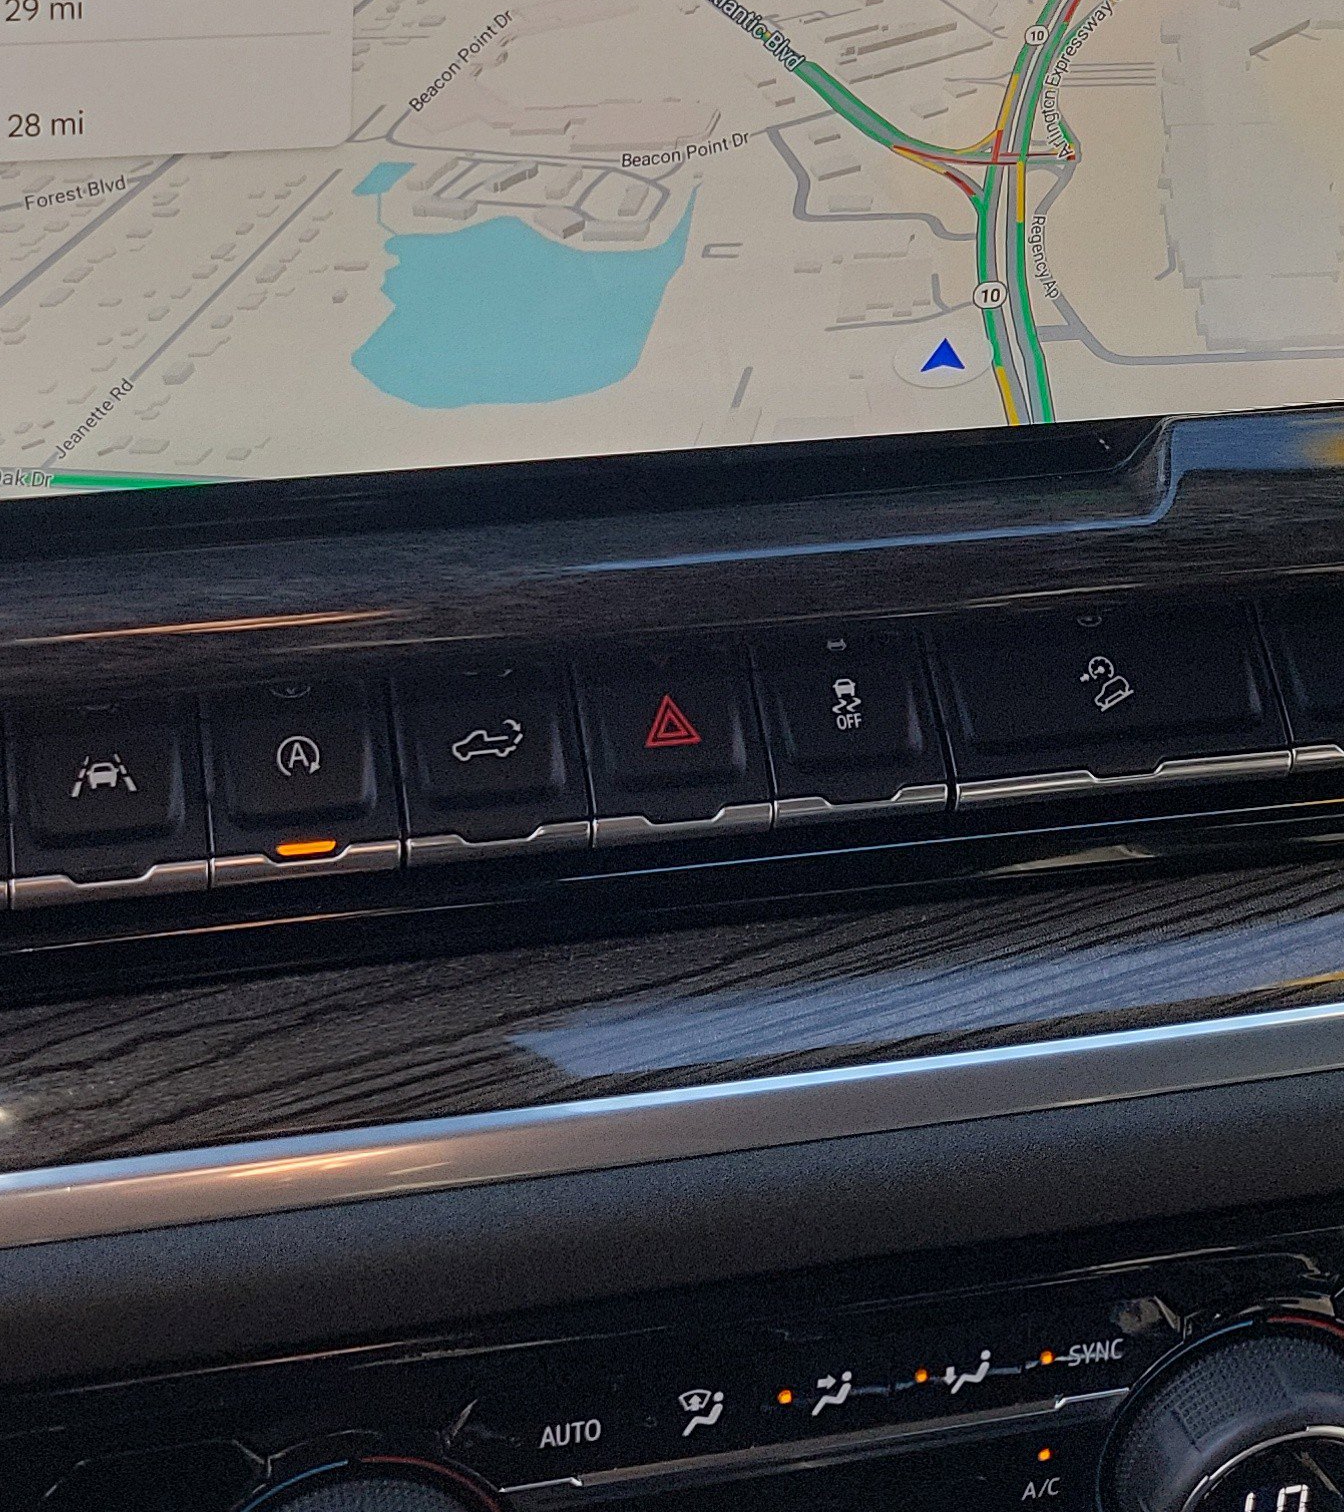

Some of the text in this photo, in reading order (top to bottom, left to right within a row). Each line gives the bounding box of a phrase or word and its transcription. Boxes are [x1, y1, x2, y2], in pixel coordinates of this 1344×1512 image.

[763, 30, 806, 73] Blvd
[1030, 30, 1045, 42] 10
[1044, 0, 1114, 88] Expressway
[408, 9, 514, 112] Beacon Point Dr
[7, 113, 42, 139] 28
[50, 110, 85, 136] mi
[1041, 90, 1074, 161] Arlington
[621, 132, 750, 168] Beacon Point Dr
[23, 174, 127, 212] Forest Blvd
[1027, 215, 1050, 278] Regency
[981, 288, 1001, 303] 10
[56, 377, 135, 461] Jeanette Rd
[29, 470, 53, 489] Dr
[835, 712, 863, 731] OFF
[1068, 1337, 1125, 1368] SYNC
[539, 1418, 603, 1450] AUTO
[1021, 1477, 1061, 1502] A/C
